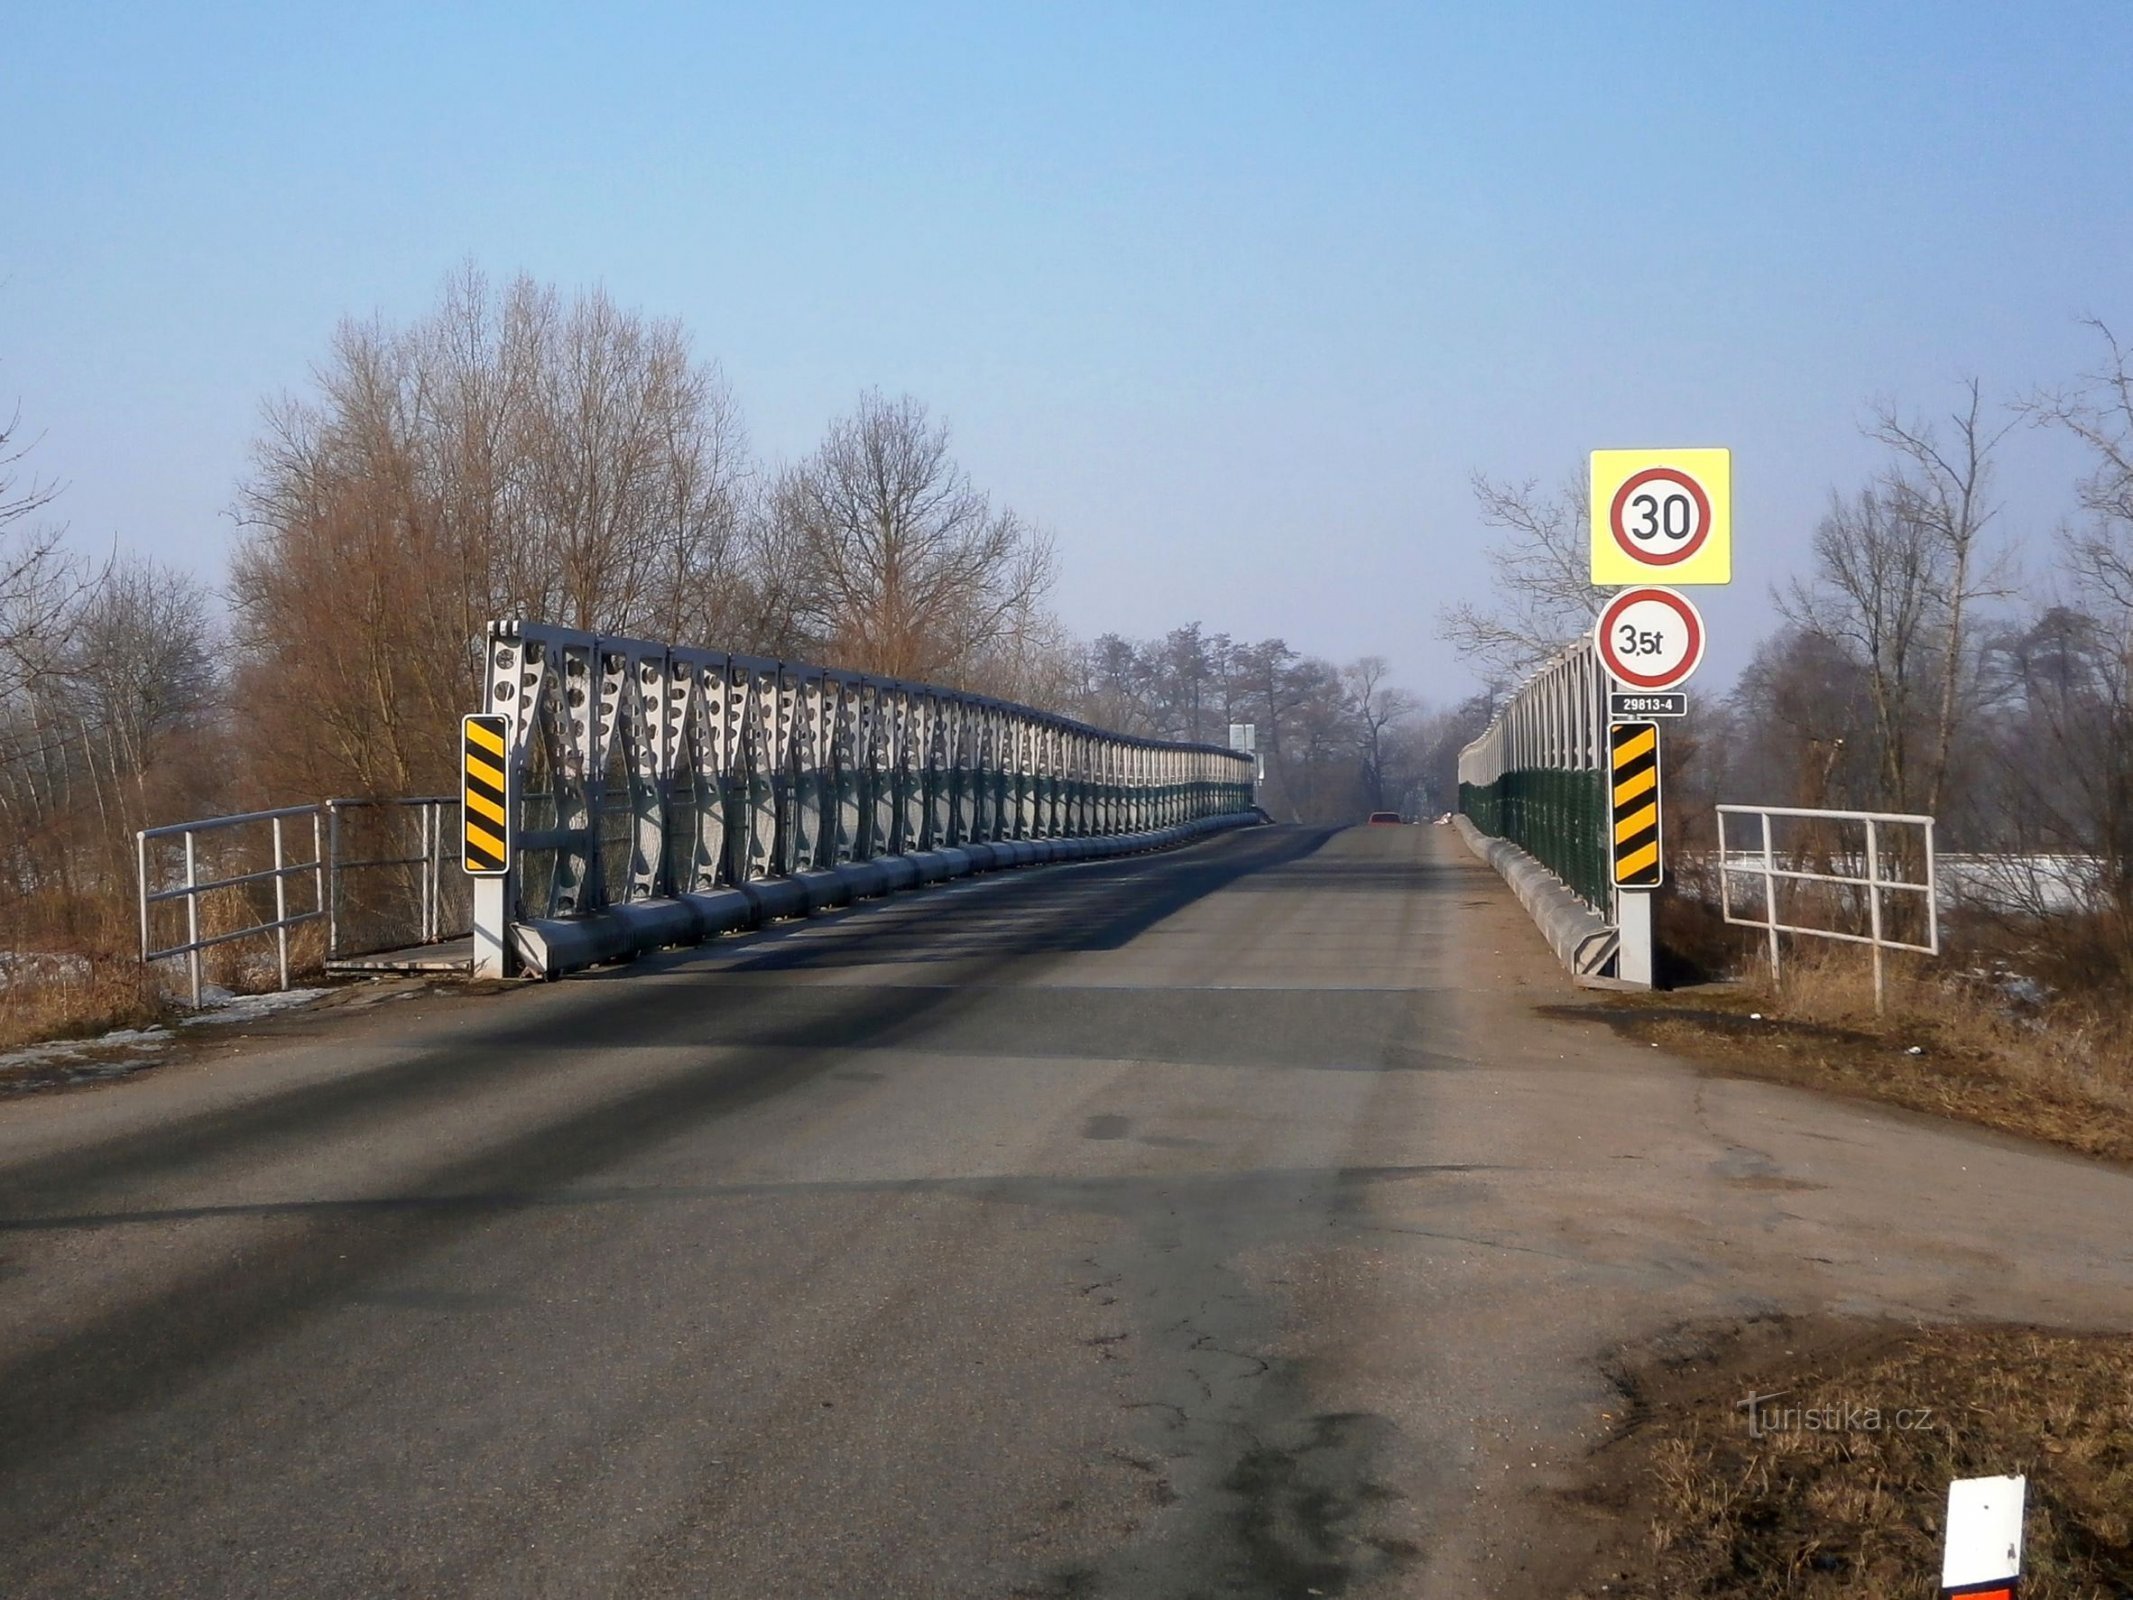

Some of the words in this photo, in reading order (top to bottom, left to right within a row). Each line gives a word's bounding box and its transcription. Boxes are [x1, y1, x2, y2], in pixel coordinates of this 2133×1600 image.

[1632, 494, 1690, 540] 30
[1619, 624, 1664, 656] 3,5t
[1623, 698, 1673, 710] 29813-4
